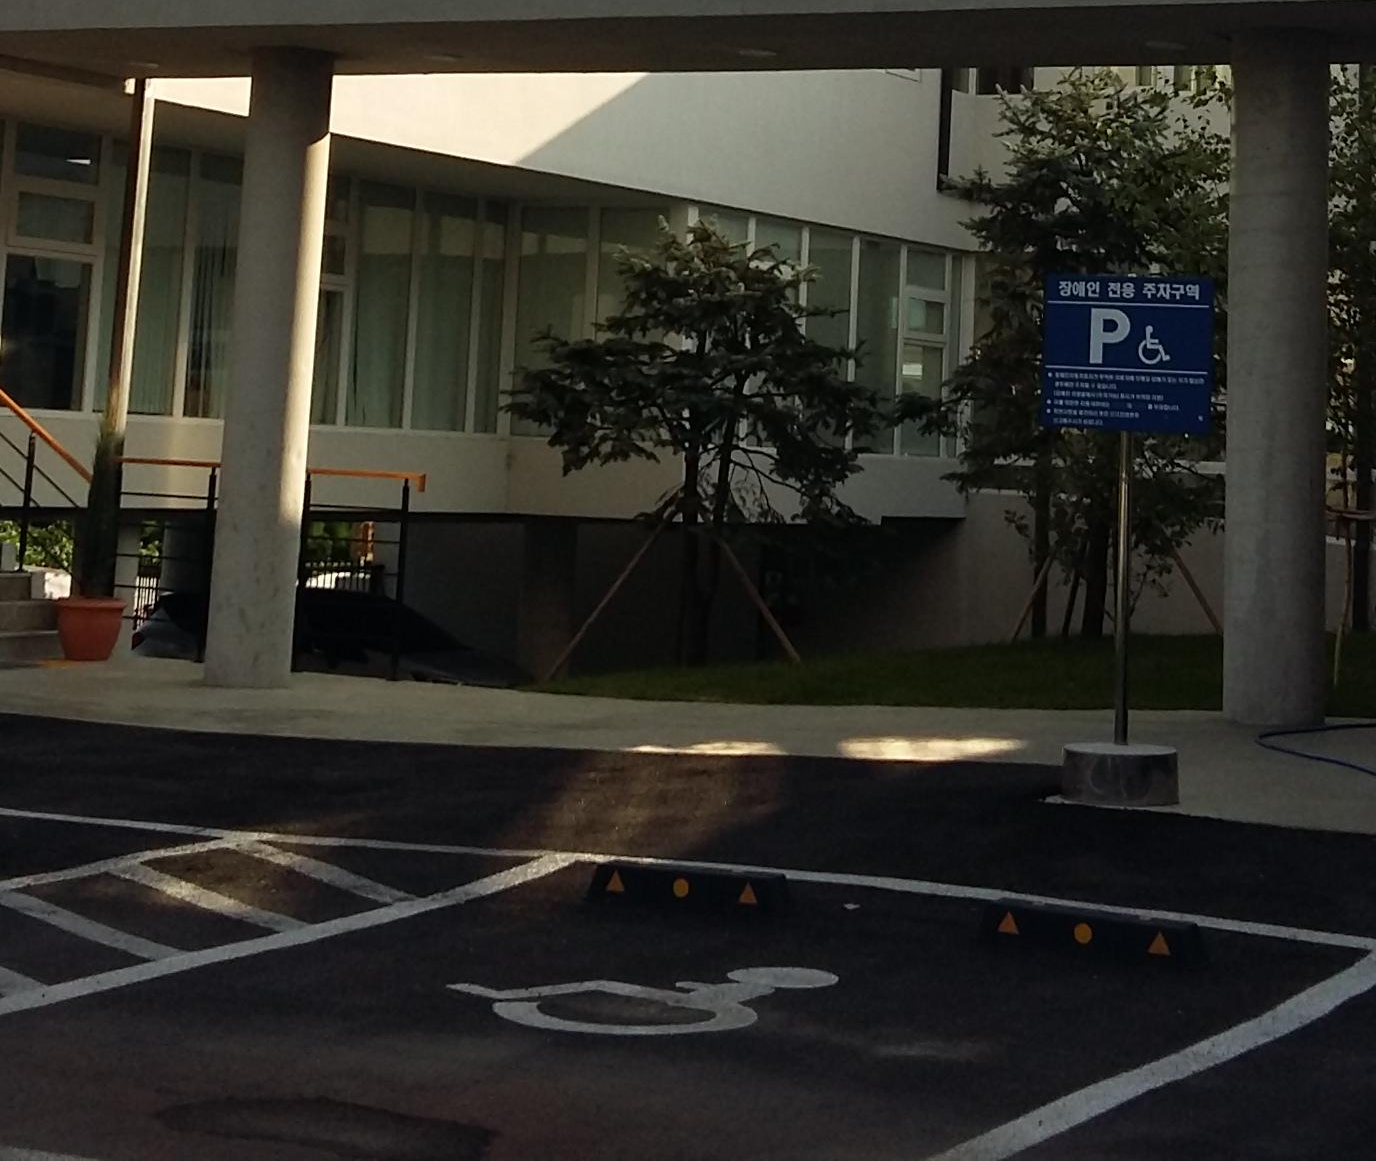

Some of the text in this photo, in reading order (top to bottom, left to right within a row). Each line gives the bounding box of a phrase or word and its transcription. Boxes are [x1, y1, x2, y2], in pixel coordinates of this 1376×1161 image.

[1058, 280, 1200, 300] 장애인 전용 주차구역
[1089, 307, 1131, 364] P
